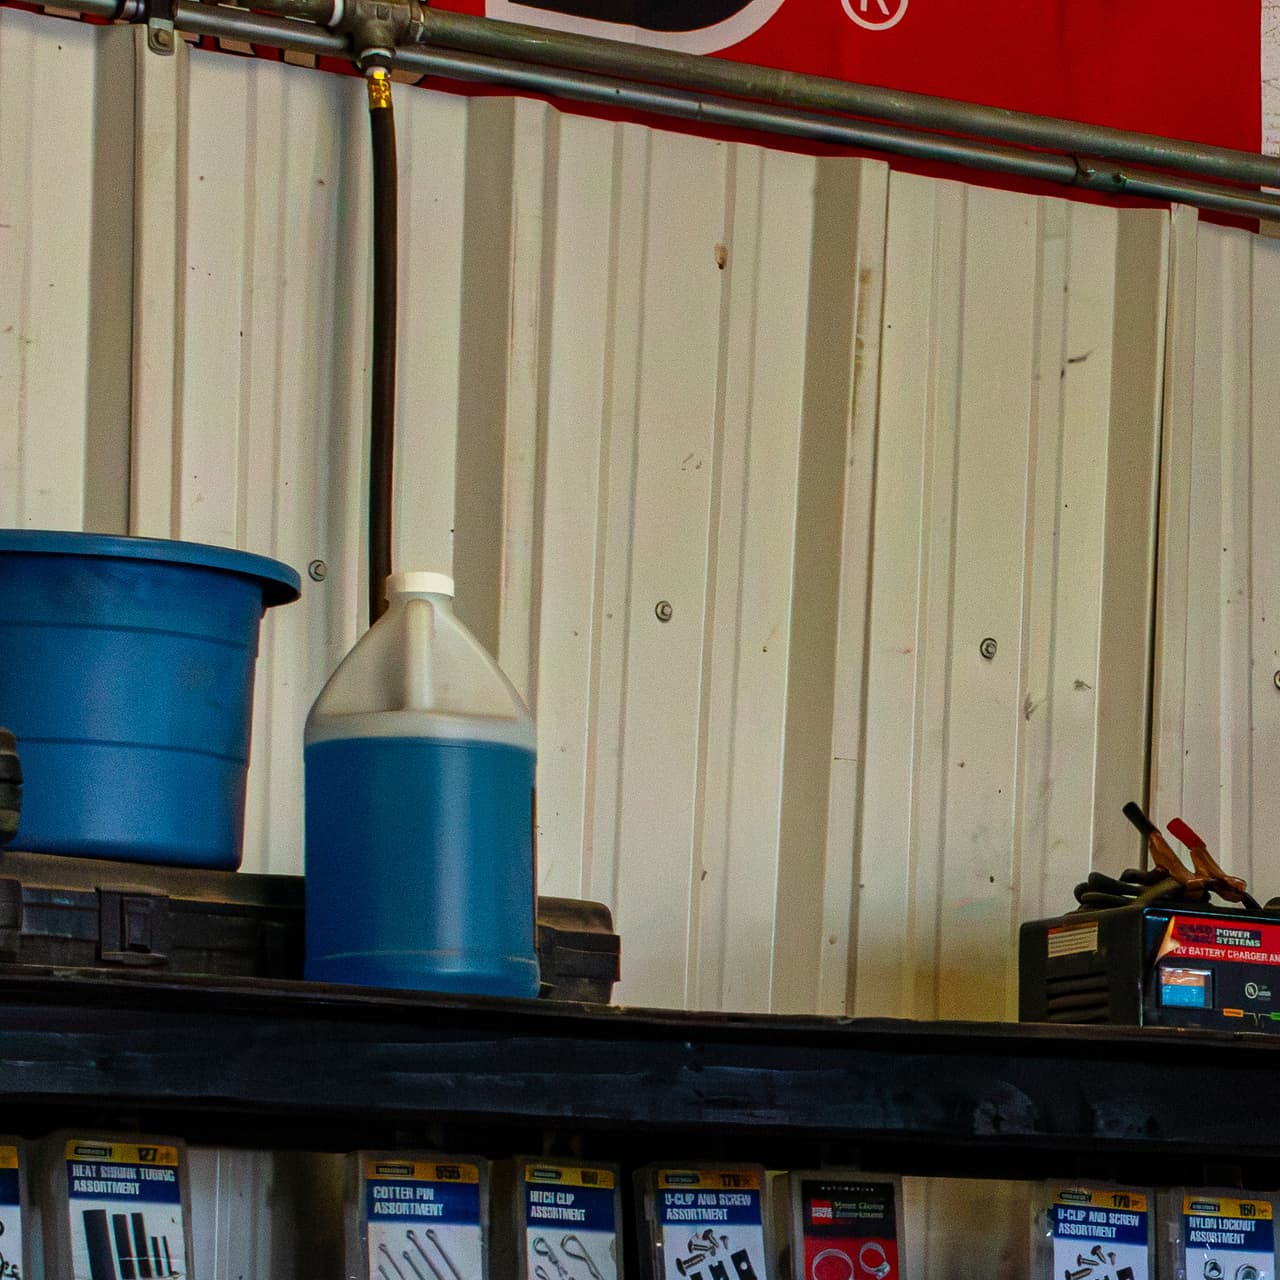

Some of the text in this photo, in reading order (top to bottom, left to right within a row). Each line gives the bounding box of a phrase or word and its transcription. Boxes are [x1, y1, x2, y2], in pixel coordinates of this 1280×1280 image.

[1216, 928, 1250, 938] POWER
[1216, 937, 1260, 947] SYSTEMS
[1188, 946, 1225, 958] BATTERY
[1227, 951, 1266, 961] CHARGER
[72, 1164, 97, 1177] HEAT
[139, 1168, 175, 1182] TUBING
[73, 1180, 141, 1195] ASSORTMENT
[373, 1186, 434, 1201] COTTER PIN
[530, 1191, 575, 1205] HITCH CLIP
[665, 1193, 752, 1206] U-CLIP AND SCREW
[374, 1202, 444, 1217] ASSORTMENT
[530, 1206, 586, 1221] ASSORTMENT
[666, 1208, 729, 1221] ASSORTMENT
[1057, 1208, 1140, 1227] U-CLIP AND SCREW
[1189, 1216, 1256, 1232] NYLON LOCKNUT
[1058, 1222, 1117, 1238] ASSORTMENT
[1190, 1230, 1245, 1245] ASSORTMENT
